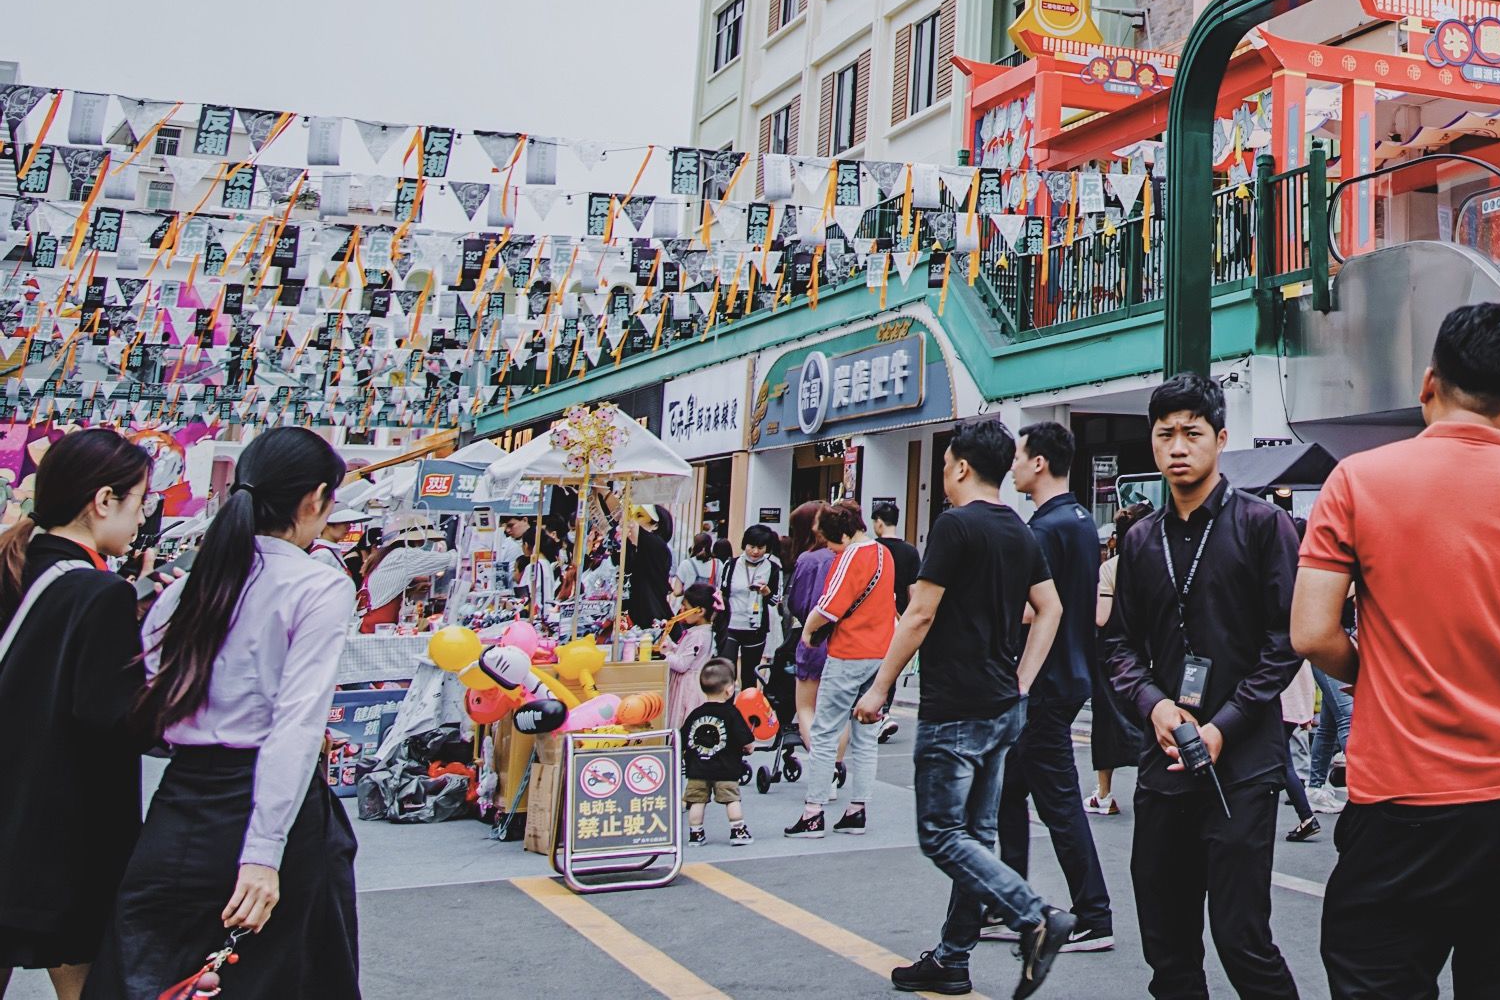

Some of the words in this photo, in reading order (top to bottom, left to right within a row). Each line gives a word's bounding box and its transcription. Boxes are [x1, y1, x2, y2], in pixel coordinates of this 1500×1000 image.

[199, 109, 232, 156] 反潮
[423, 131, 452, 177] 反潮
[674, 152, 699, 194] 反潮
[838, 165, 859, 204] 反潮
[980, 172, 1000, 213] 反潮
[35, 235, 57, 267] 反潮
[95, 212, 120, 251] 反潮
[1027, 220, 1043, 253] 反潮
[425, 476, 450, 491] 双汇
[579, 795, 667, 815] 电动车、自行车
[577, 812, 668, 839] 禁止驶入
